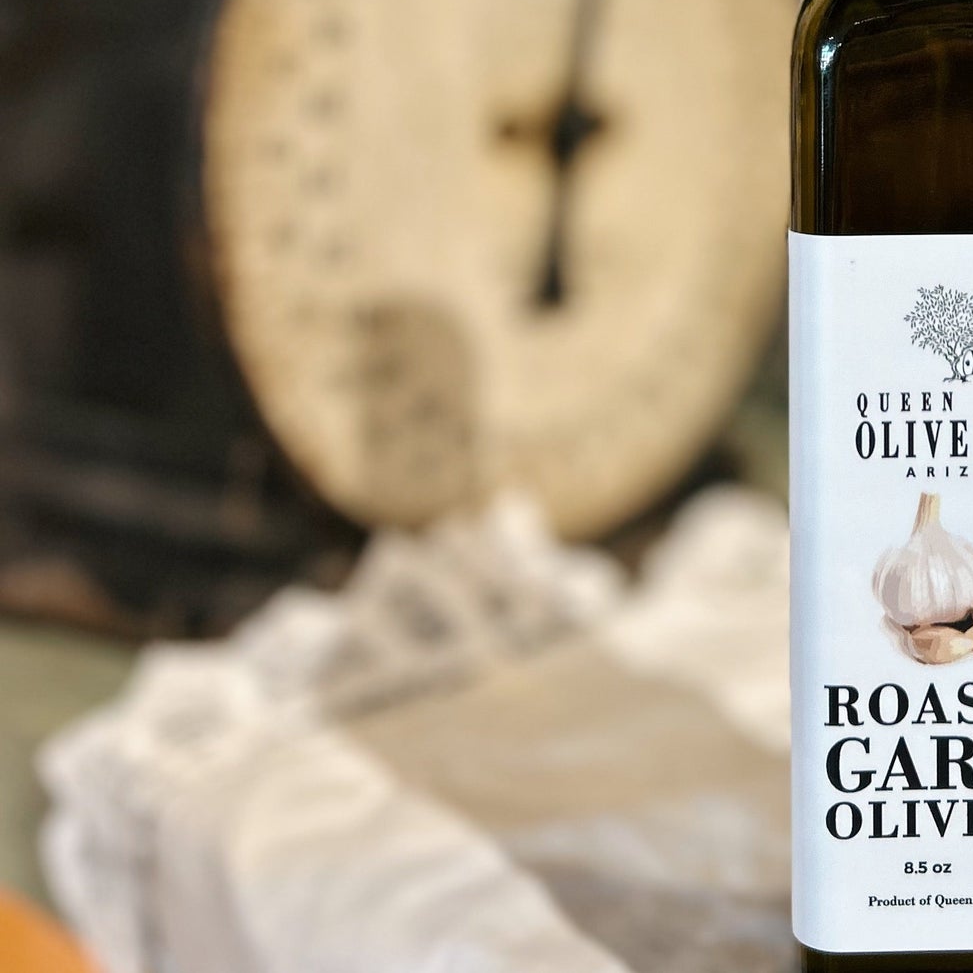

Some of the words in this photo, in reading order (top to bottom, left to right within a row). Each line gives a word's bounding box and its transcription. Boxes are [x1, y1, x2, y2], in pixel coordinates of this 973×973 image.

[857, 392, 952, 418] QUEEN
[856, 420, 968, 459] OLIVE
[903, 860, 928, 875] 8.5
[932, 862, 952, 874] oz
[868, 895, 916, 907] Product
[919, 894, 933, 906] of
[934, 893, 973, 909] Queen
